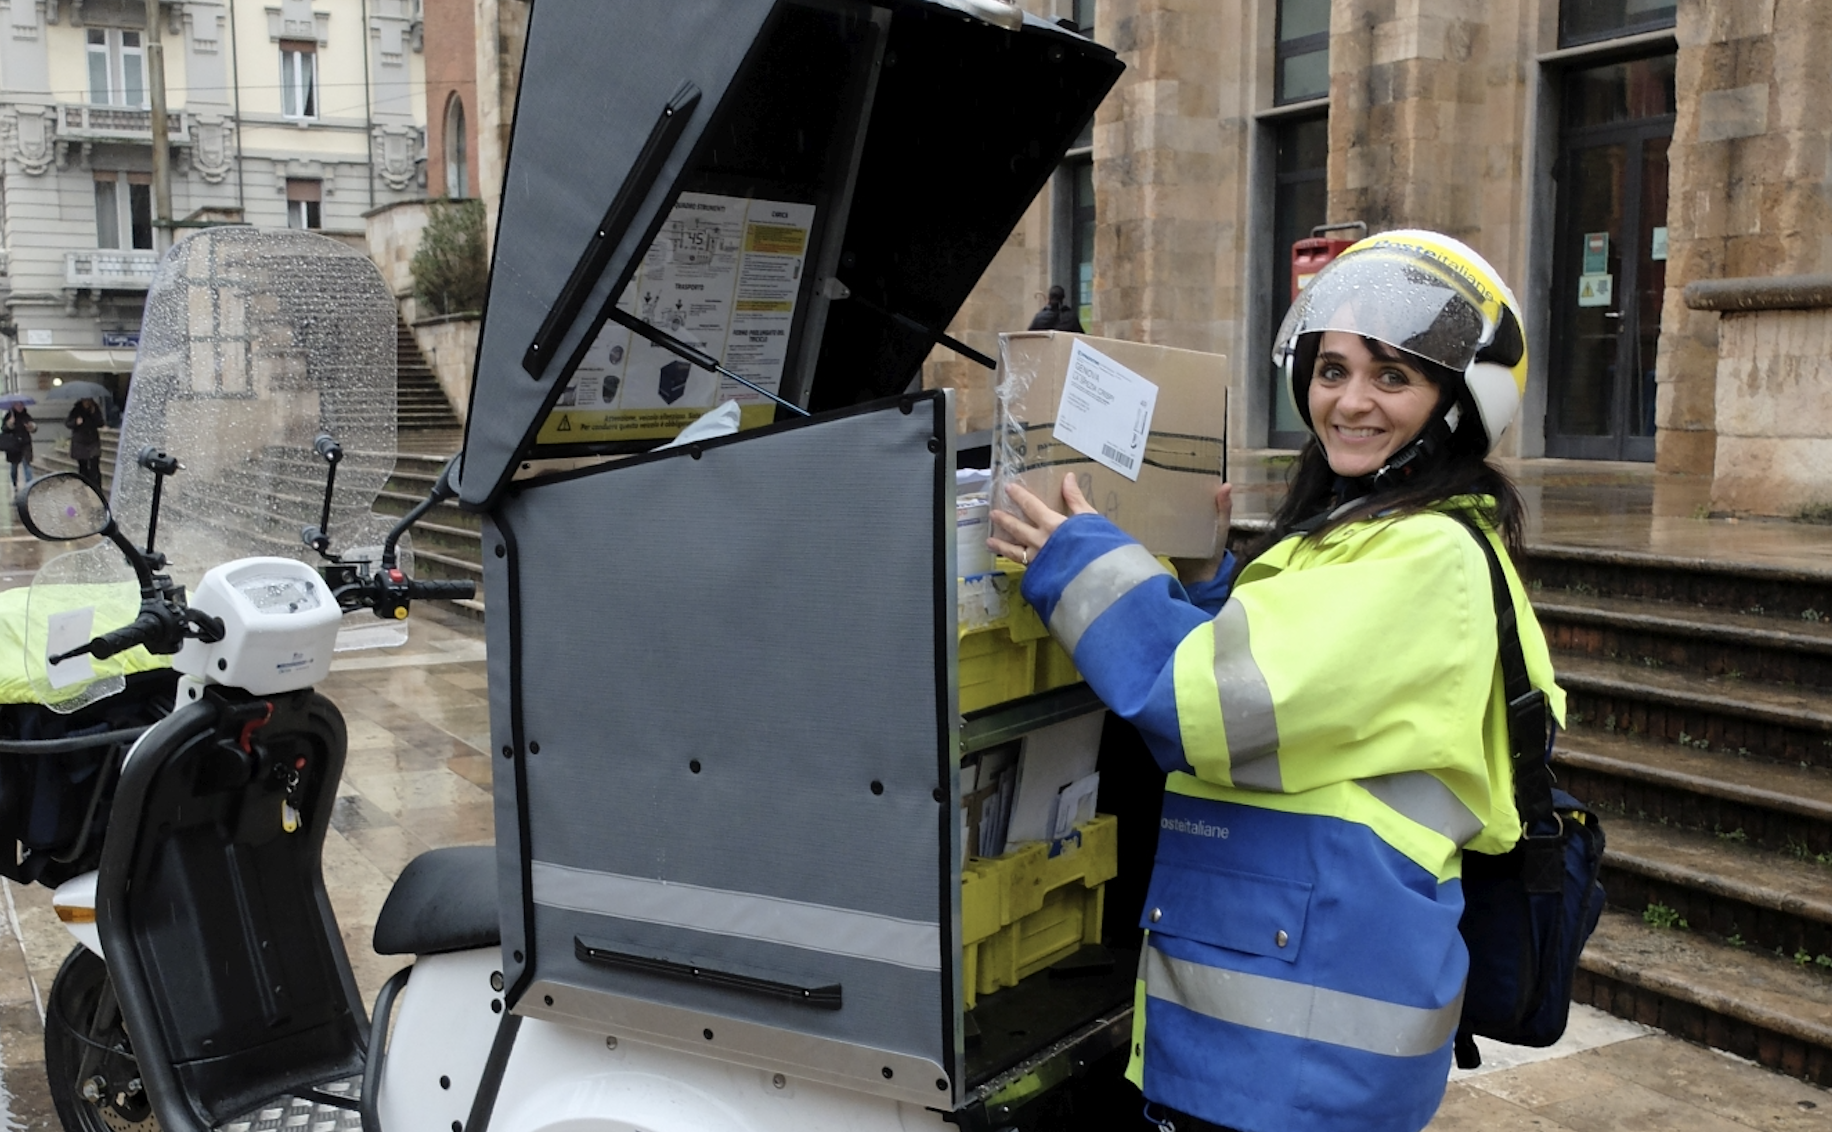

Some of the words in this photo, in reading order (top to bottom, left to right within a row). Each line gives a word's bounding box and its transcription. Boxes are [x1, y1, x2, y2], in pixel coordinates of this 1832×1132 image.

[675, 282, 704, 291] TRASPORTO
[1075, 361, 1100, 383] GENOVA
[1160, 817, 1230, 840] osteitaliane
